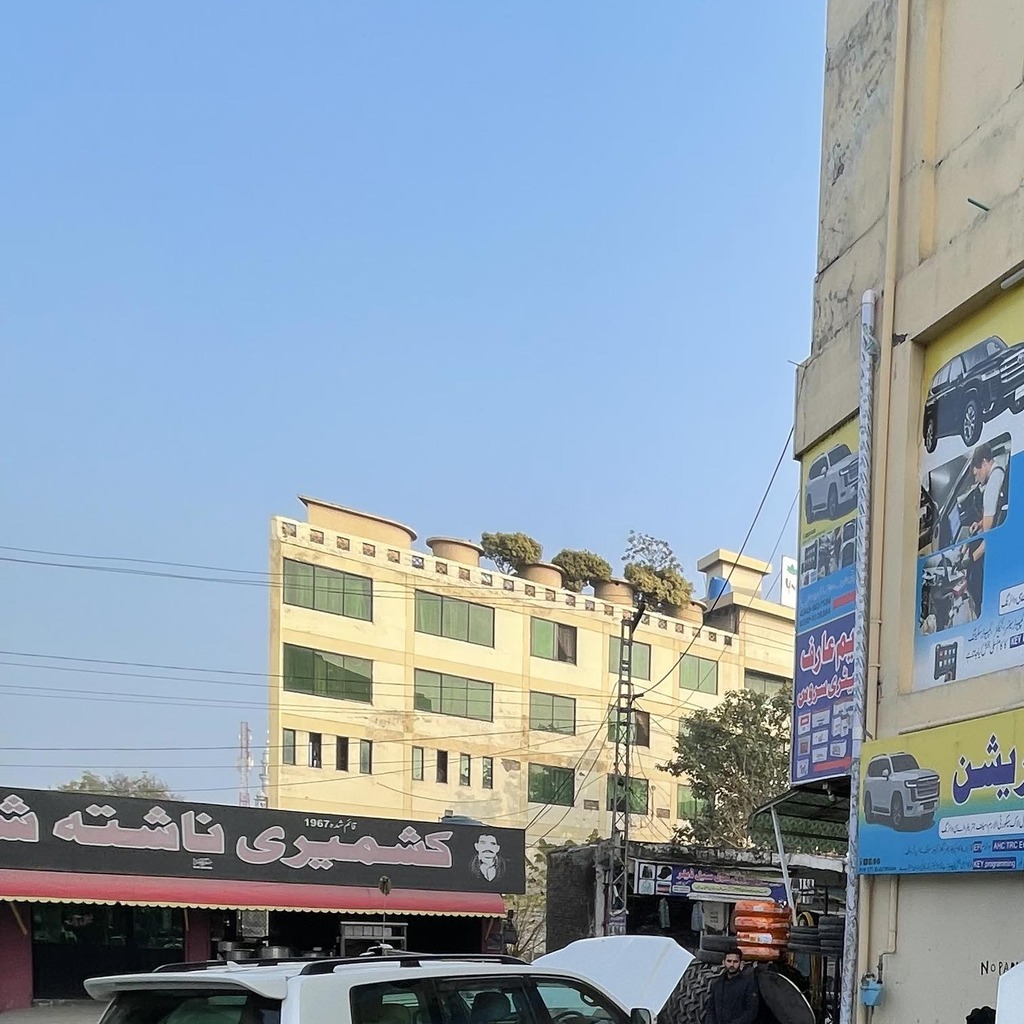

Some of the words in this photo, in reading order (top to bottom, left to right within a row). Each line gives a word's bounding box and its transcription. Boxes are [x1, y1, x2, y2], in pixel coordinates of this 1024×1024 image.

[52, 803, 225, 854] ناشتہ
[304, 817, 329, 828] 1967
[235, 825, 454, 870] کشمیری
[993, 841, 1006, 850] AHC
[1006, 840, 1019, 849] TRC
